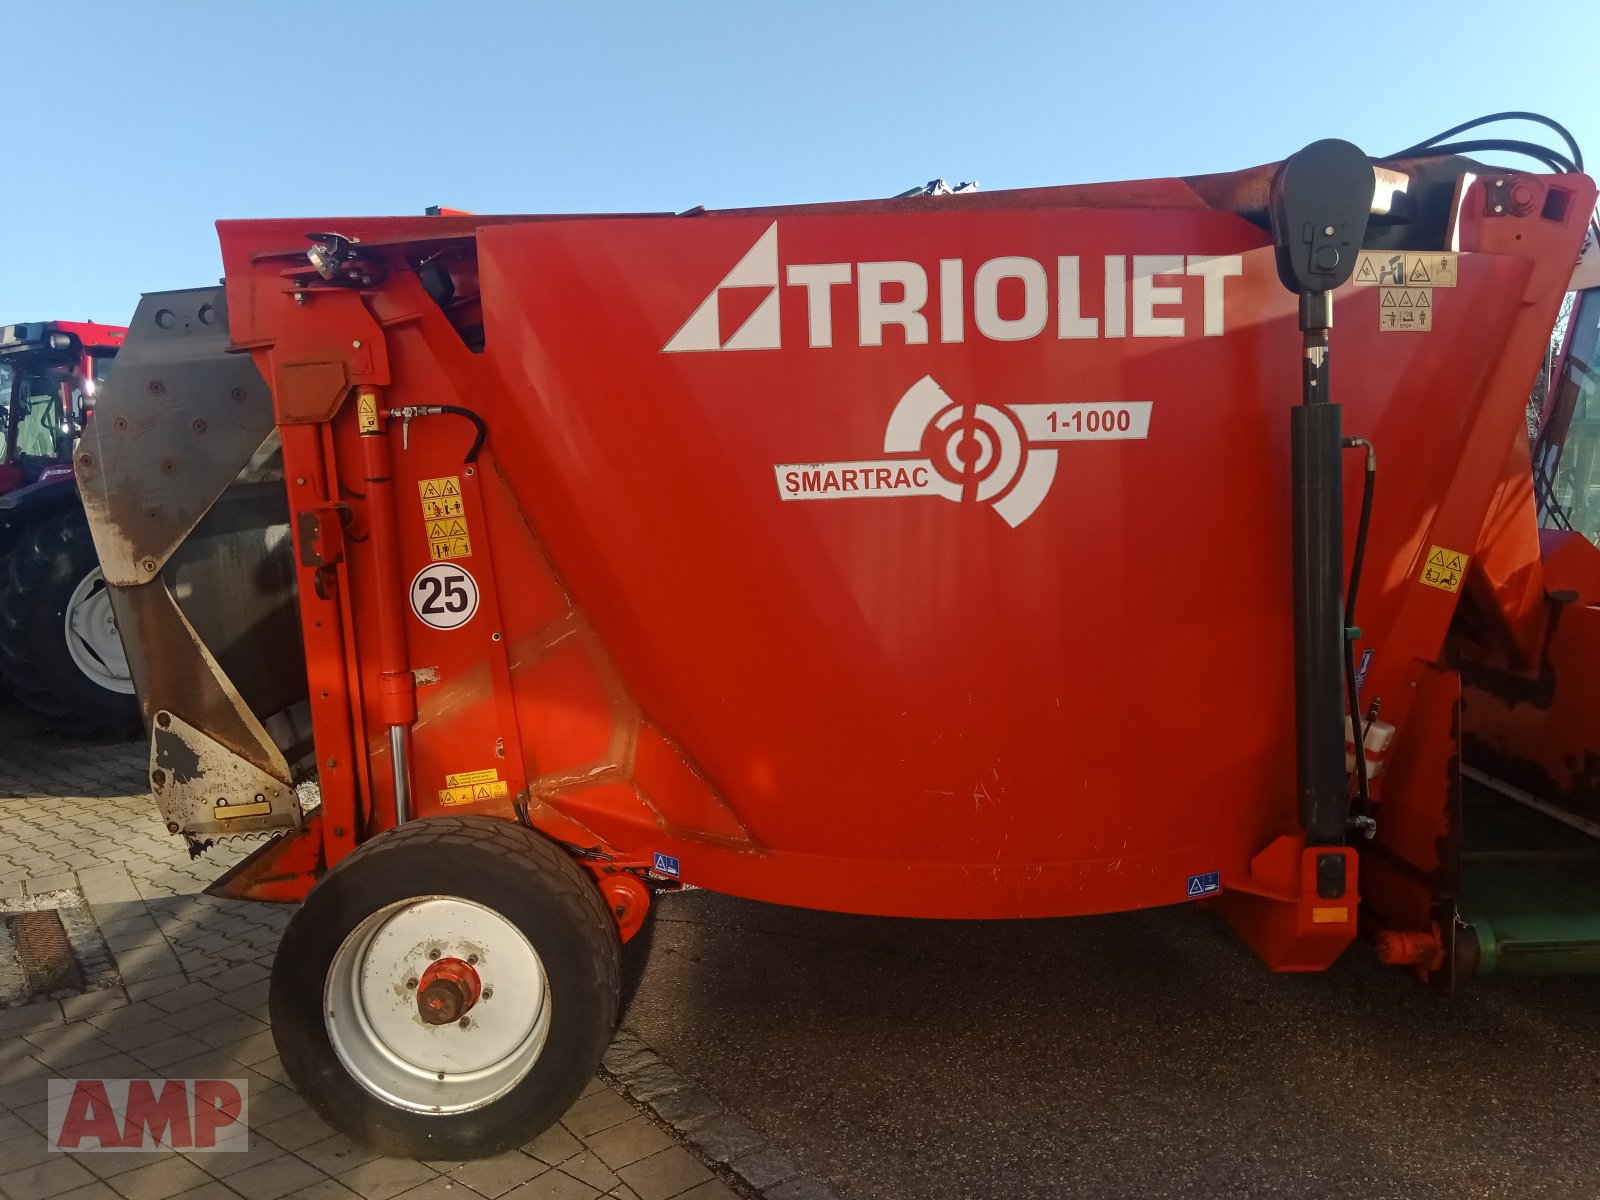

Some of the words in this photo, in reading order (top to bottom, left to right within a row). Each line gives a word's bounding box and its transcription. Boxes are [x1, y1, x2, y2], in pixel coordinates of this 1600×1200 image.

[786, 255, 1243, 348] TRIOLIET
[1046, 410, 1131, 433] 1-1000
[785, 466, 929, 493] SMARTRAC
[418, 575, 468, 615] 25
